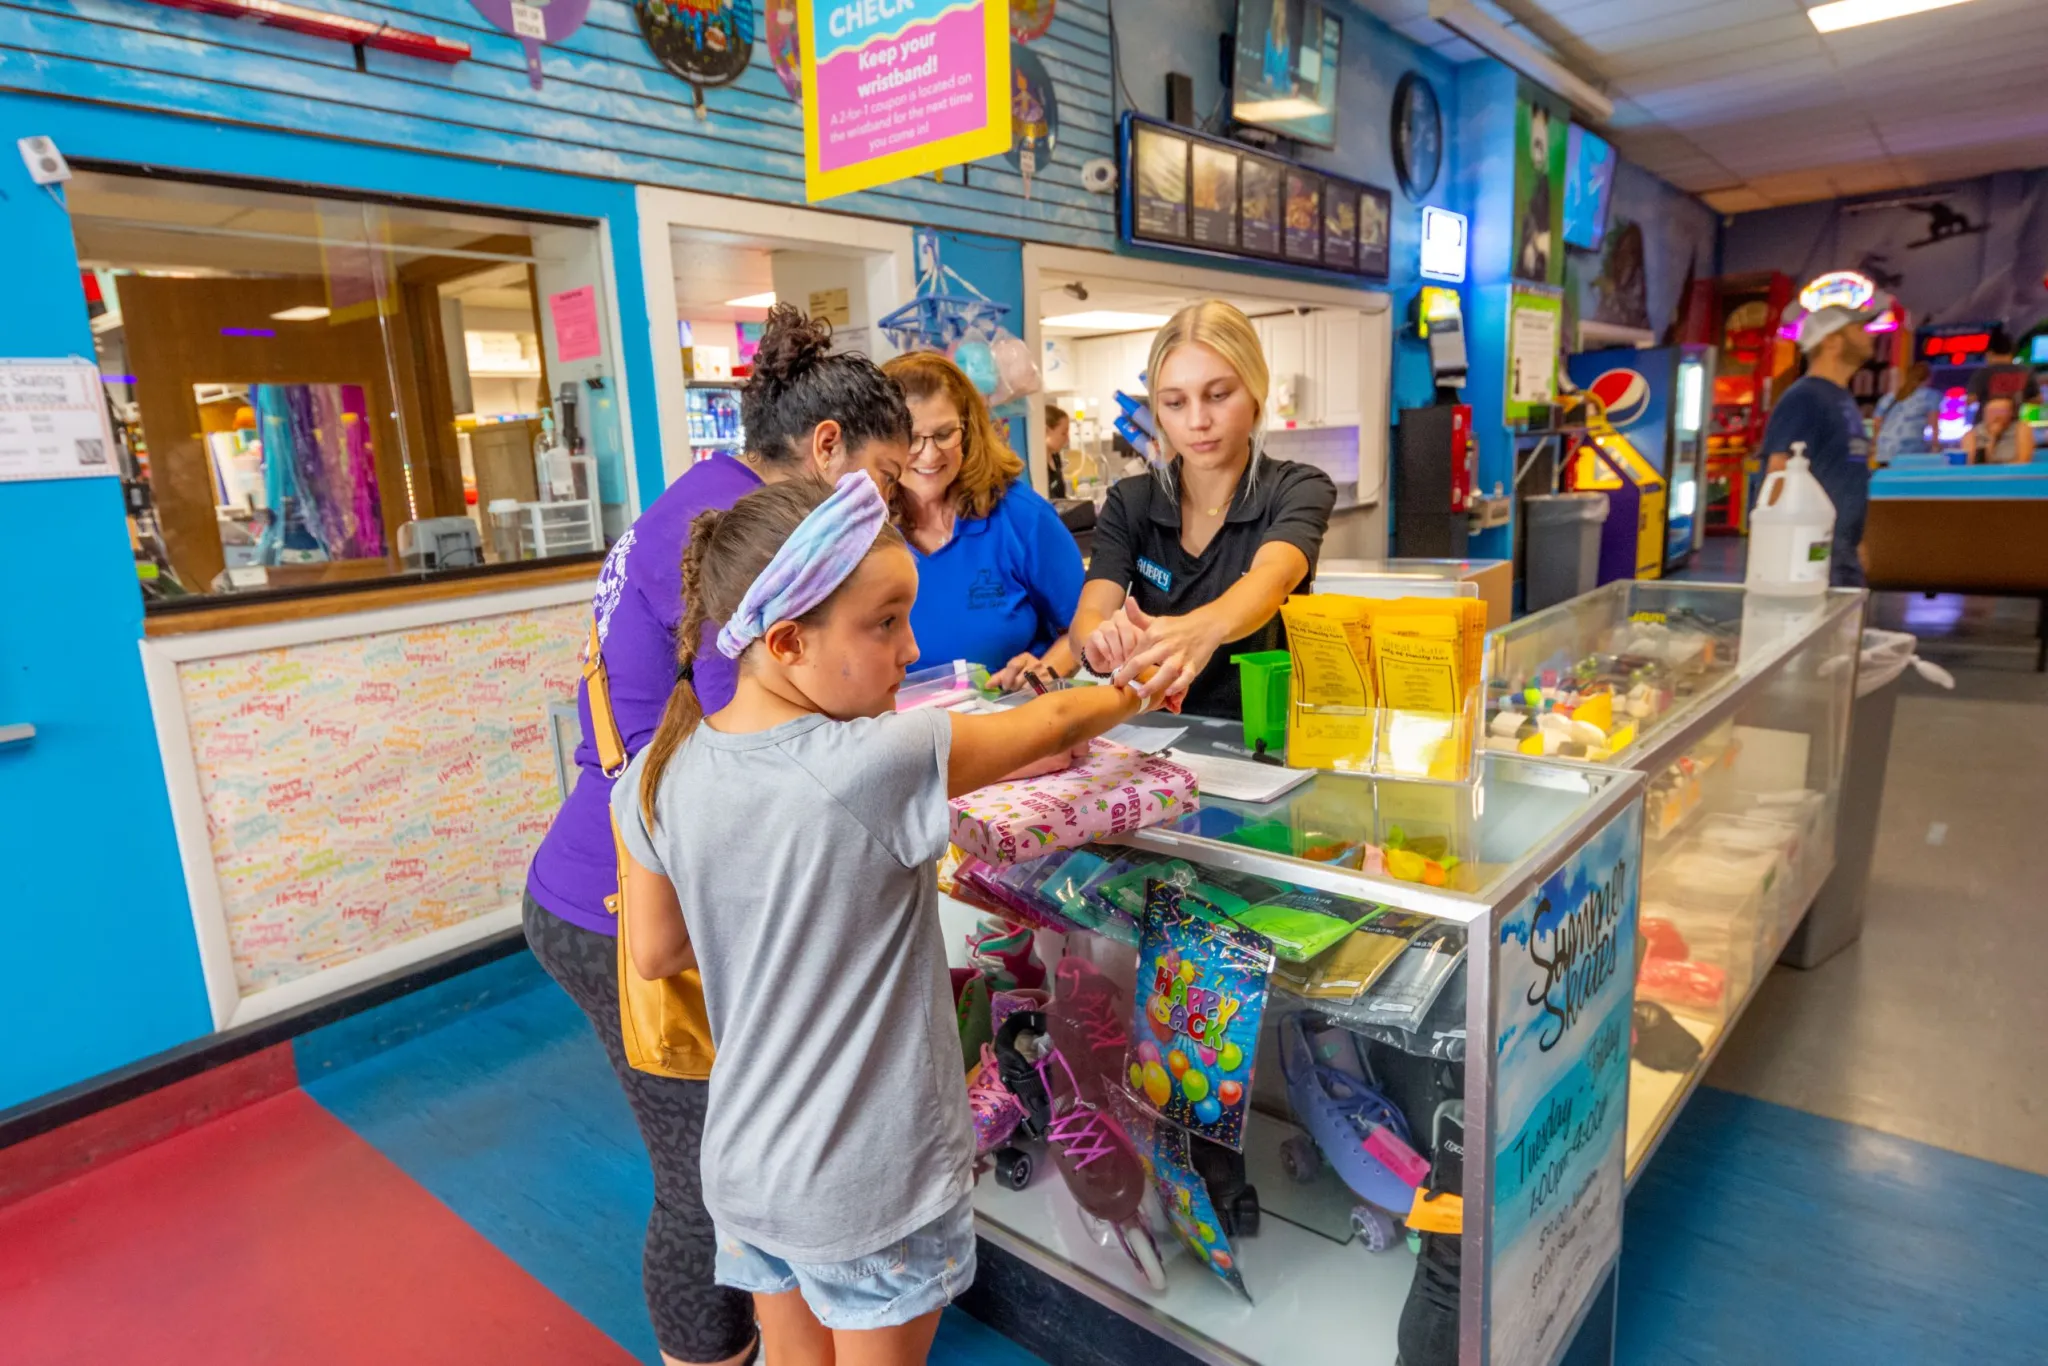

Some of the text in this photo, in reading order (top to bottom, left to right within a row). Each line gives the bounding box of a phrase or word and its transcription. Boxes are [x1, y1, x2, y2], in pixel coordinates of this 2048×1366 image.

[857, 55, 939, 98] wristband!
[858, 32, 937, 71] Keep your
[830, 73, 972, 126] A 2-for-1 coupon is located on
[830, 92, 973, 144] the wristband for the next time
[868, 137, 887, 152] you
[888, 129, 915, 143] come
[1140, 766, 1176, 783] GIRL
[1029, 791, 1077, 827] BIRTHDAY
[1527, 858, 1626, 1006] Summer
[1154, 965, 1240, 1025] HAPPY
[1539, 925, 1616, 1052] Skates
[1154, 993, 1226, 1051] SACK
[1513, 1098, 1572, 1184] Tuesday
[1587, 1022, 1622, 1089] Friday
